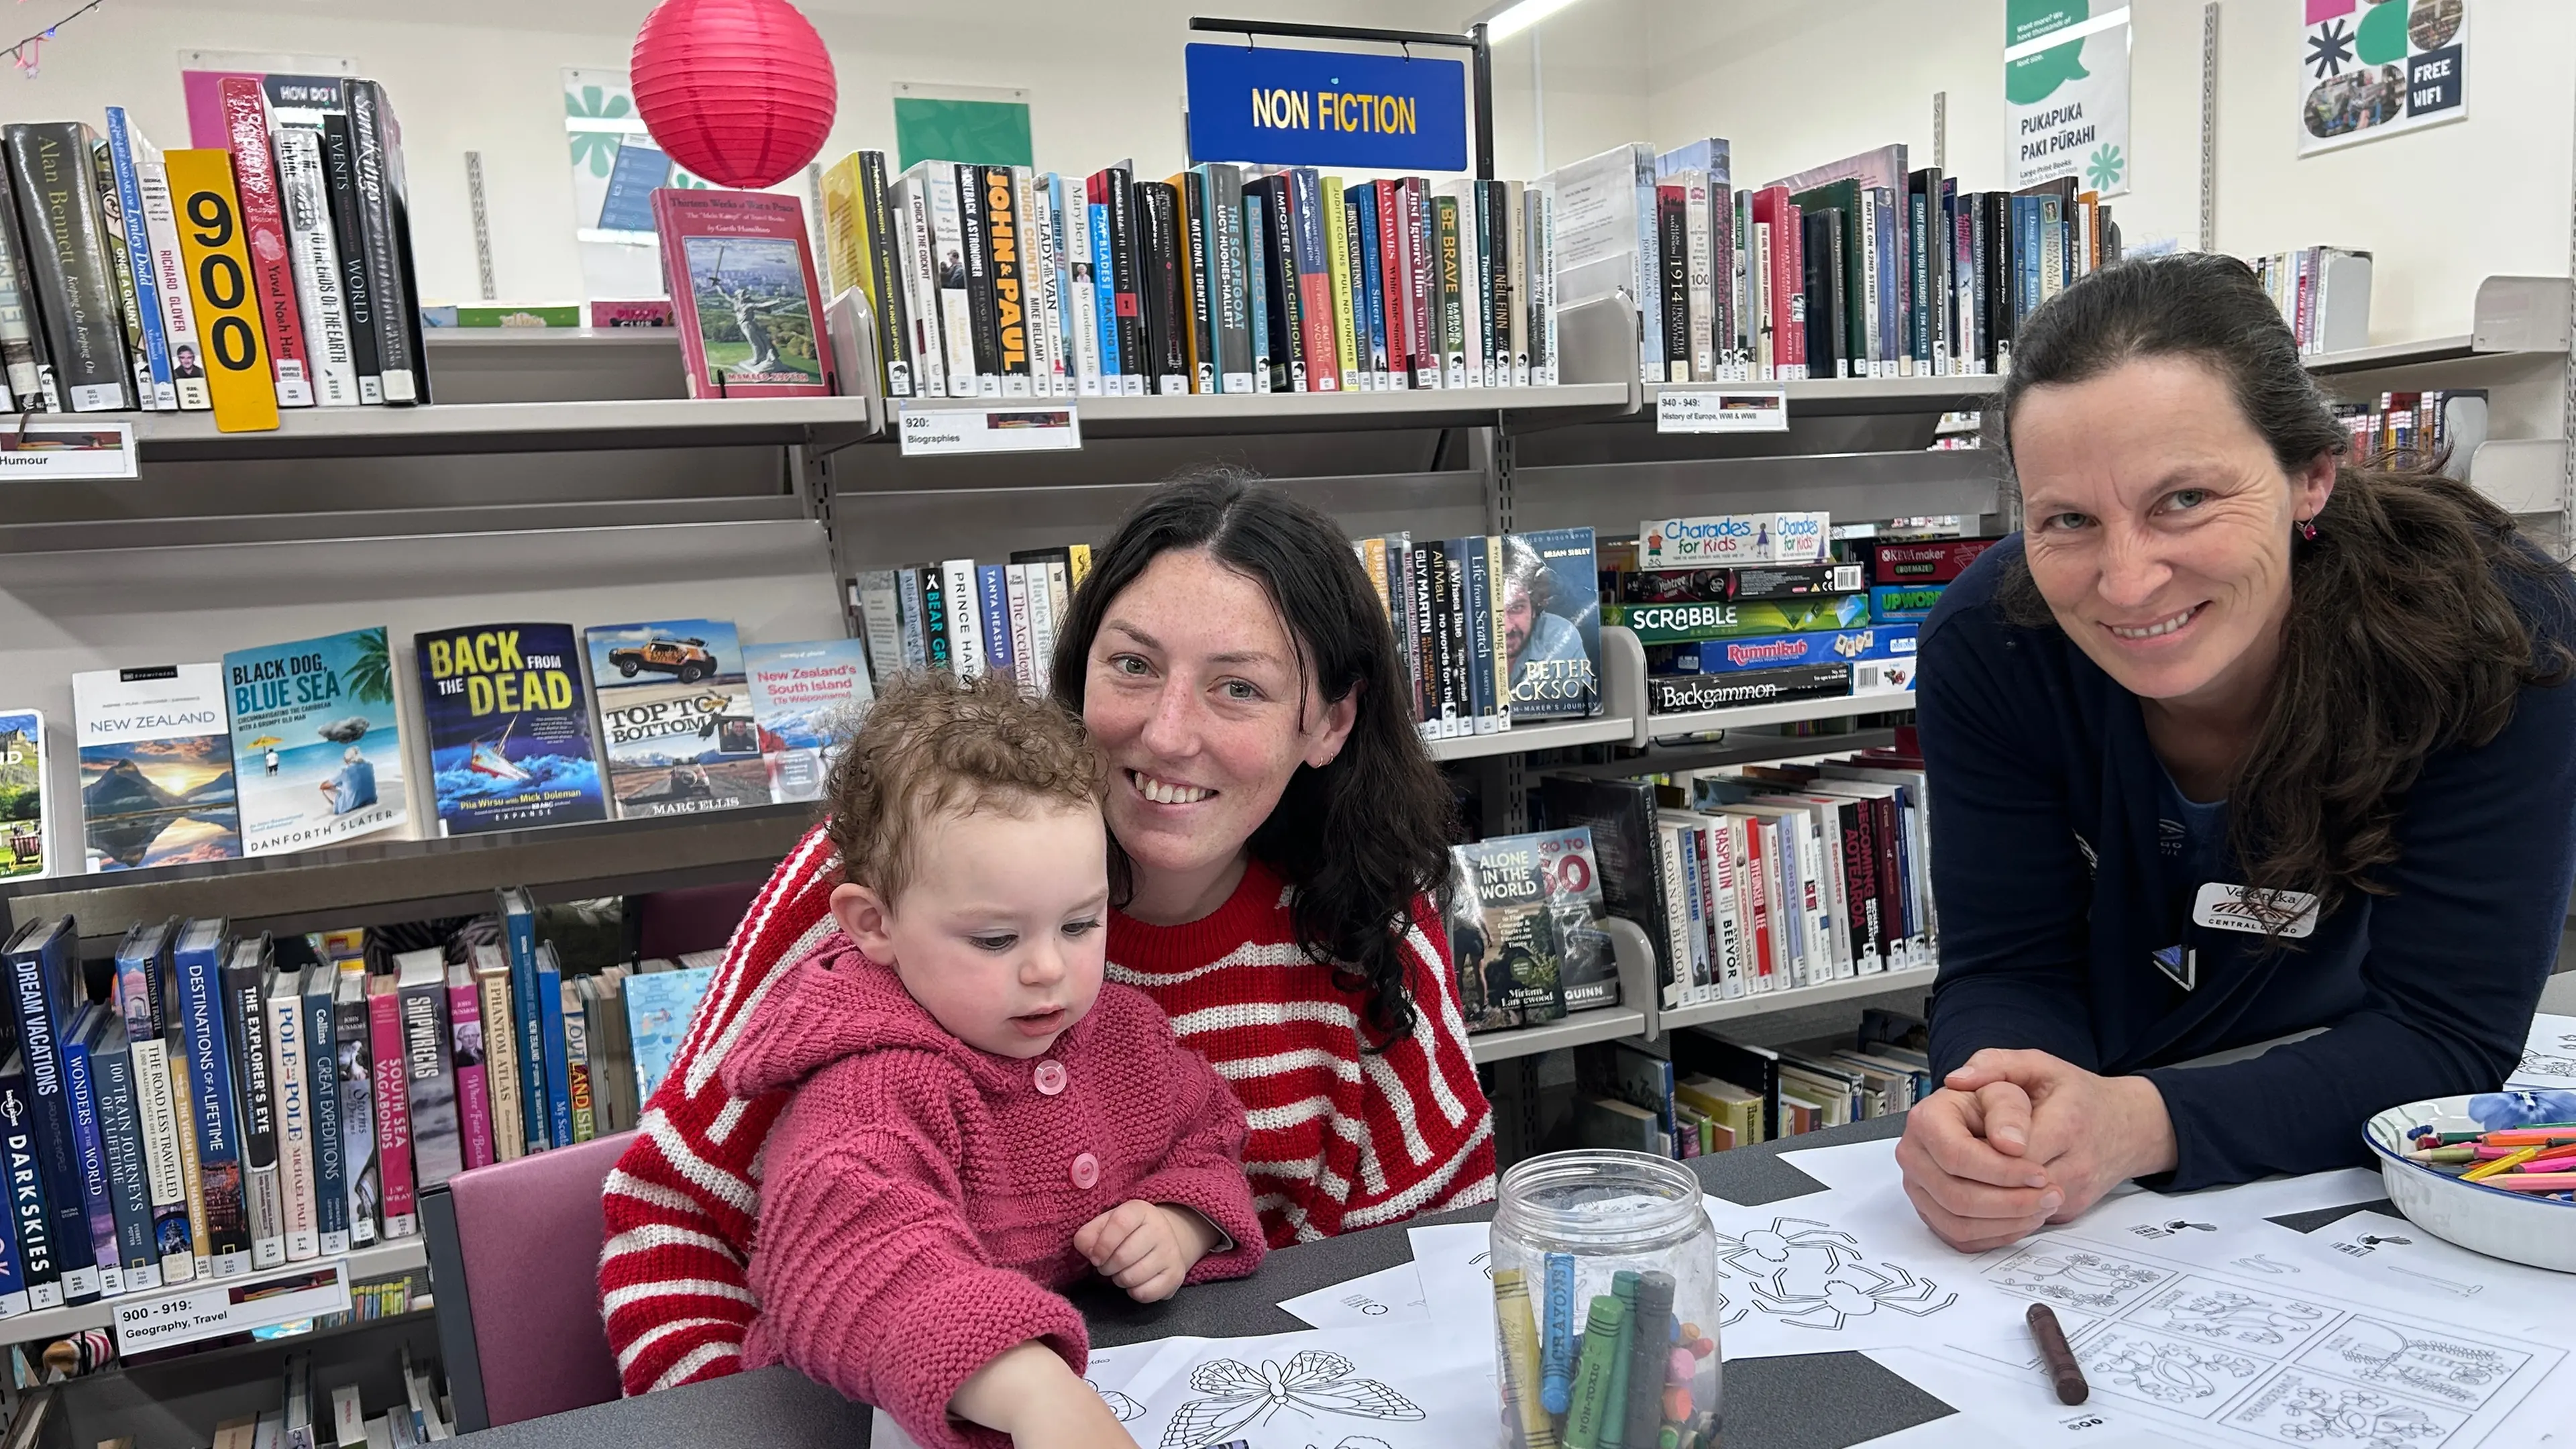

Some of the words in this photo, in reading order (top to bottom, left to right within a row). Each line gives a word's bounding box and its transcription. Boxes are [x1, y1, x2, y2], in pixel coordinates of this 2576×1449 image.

[2414, 59, 2451, 83] FREE
[1252, 88, 1309, 129] NON
[1318, 92, 1416, 134] FICTION
[2413, 87, 2441, 107] WIFI
[2021, 102, 2082, 136] PUKAPUKA
[38, 136, 60, 182] Alan
[2021, 139, 2047, 161] PAKI
[2051, 125, 2095, 153] PŪRAHI
[2020, 168, 2036, 179] Large
[2037, 162, 2052, 174] Print
[2053, 159, 2072, 170] Books
[987, 170, 1015, 262] JOHN
[1228, 205, 1238, 233] THE
[1333, 188, 1342, 221] JUDITH
[1441, 208, 1454, 230] BE
[48, 191, 74, 264] Bennett
[1277, 191, 1290, 253] IMPOSTER
[1191, 219, 1204, 270] NATIONAL
[1336, 226, 1346, 267] COLLINS
[1000, 263, 1012, 276] &
[1284, 258, 1295, 290] MATT
[1444, 236, 1458, 292] BRAVE
[160, 250, 178, 290] RICHARD
[170, 297, 186, 331] GLOVER
[187, 191, 257, 371] 900
[347, 258, 368, 323] WORLD
[1195, 273, 1208, 322] IDENTITY
[1230, 237, 1244, 329] SCAPEGOAT
[1340, 273, 1348, 294] PULL
[1495, 274, 1507, 299] NEIL
[1670, 260, 1684, 302] 1914
[997, 278, 1025, 370] PAUL
[1030, 297, 1040, 321] MIKE
[1287, 292, 1302, 358] CHISHOLM
[1496, 302, 1508, 329] FINN
[1032, 323, 1044, 362] BELLAMY
[1344, 318, 1354, 362] PUNCHES
[906, 417, 930, 428] 920:
[1662, 413, 1684, 421] History
[1694, 413, 1717, 421] Europe,
[908, 434, 960, 444] Biographies
[0, 456, 48, 465] Humour
[1665, 517, 1751, 539] Charades
[1776, 516, 1819, 536] Charades
[1432, 551, 1444, 569] Ali
[1544, 549, 1566, 559] BRIAN
[1567, 548, 1591, 557] SIBLEY
[1678, 539, 1700, 554] for
[1703, 537, 1737, 555] Kids
[1784, 537, 1796, 551] for
[1796, 536, 1813, 551] Kids
[1415, 550, 1428, 578] GUY
[1471, 555, 1486, 582] Life
[987, 570, 998, 608] TANYA
[1434, 570, 1444, 603] Mau
[1474, 584, 1483, 607] from
[927, 591, 943, 632] BEAR
[1417, 579, 1432, 634] MARTIN
[1438, 613, 1446, 629] no
[1633, 606, 1737, 631] SCRABBLE
[955, 572, 970, 633] PRINCE
[963, 641, 974, 676] HAR
[991, 610, 1004, 659] HEASLIP
[1475, 610, 1491, 658] Scratch
[429, 630, 524, 680] BACK
[527, 655, 561, 669] FROM
[1440, 632, 1450, 665] words
[1727, 639, 1808, 664] Rummikub
[232, 659, 287, 687] BLACK
[289, 653, 328, 674] DOG,
[757, 670, 788, 682] New
[792, 663, 857, 680] Zealand's
[1442, 667, 1452, 685] for
[1525, 659, 1596, 680] PETER
[235, 680, 292, 716] BLUE
[297, 671, 341, 705] SEA
[437, 678, 464, 696] THE
[468, 670, 572, 717] DEAD
[767, 684, 808, 696] South
[811, 678, 853, 691] Island
[1444, 686, 1454, 703] thi
[1509, 679, 1597, 702] CKSON
[1662, 682, 1777, 710] Backgammon
[91, 718, 131, 733] NEW
[136, 710, 215, 729] ZEALAND
[237, 708, 289, 724] CIRCUMNAVIGATING
[290, 707, 300, 715] THE
[301, 701, 331, 713] CARIBBEAN
[238, 724, 251, 732] WITH
[258, 718, 280, 729] GRUMPY
[281, 716, 292, 724] OLD
[612, 716, 706, 743] BOTTOM
[250, 826, 333, 852] DANFORTH
[340, 810, 394, 833] SLATER
[1479, 850, 1529, 869] ALONE
[1715, 826, 1733, 890] RASPUTIN
[1857, 800, 1875, 897] BECOMING
[1482, 870, 1499, 884] IN
[1500, 866, 1529, 882] THE
[1664, 839, 1676, 899] CROWN
[1845, 828, 1866, 929] AOTEAROA
[1480, 881, 1537, 900] WORLD
[2225, 885, 2296, 904] Veonka
[1670, 904, 1679, 921] OF
[2208, 918, 2257, 930] CENTRAL
[2259, 924, 2298, 934] OTGO
[1672, 927, 1686, 984] BLOOD
[1723, 920, 1737, 979] BEEVOR
[15, 961, 44, 1014] DREAM
[244, 986, 258, 1012] THE
[1565, 985, 1603, 1000] QUINN
[189, 965, 214, 1071] DESTINATIONS
[316, 1009, 325, 1044] Collins
[491, 987, 505, 1058] PHANTOM
[278, 1006, 298, 1066] POLE
[408, 996, 439, 1079] SHIPWRECKS
[25, 1014, 58, 1095] VACATIONS
[148, 1045, 160, 1069] THE
[248, 1016, 267, 1104] EXPLORER'S
[109, 1062, 125, 1083] 100
[152, 1071, 166, 1105] ROAD
[204, 1072, 213, 1085] OF
[317, 1057, 333, 1096] GREAT
[390, 1058, 405, 1112] SOUTH
[497, 1061, 511, 1102] ATLAS
[113, 1085, 133, 1134] TRAIN
[158, 1108, 169, 1133] LESS
[254, 1106, 269, 1134] EYE
[284, 1081, 303, 1140] POLE
[377, 1060, 392, 1150] VAGABONDS
[204, 1094, 223, 1150] LIFETIME
[394, 1118, 407, 1148] SEA
[319, 1099, 339, 1179] EXPEDITIONS
[121, 1136, 144, 1212] JOURNEYS
[160, 1135, 178, 1197] TRAVELLED
[123, 1307, 148, 1322] 900
[162, 1299, 193, 1316] 919:
[125, 1320, 191, 1339] Geography,
[193, 1310, 227, 1328] Travel
[1578, 1362, 1601, 1436] NON-TOXIC
